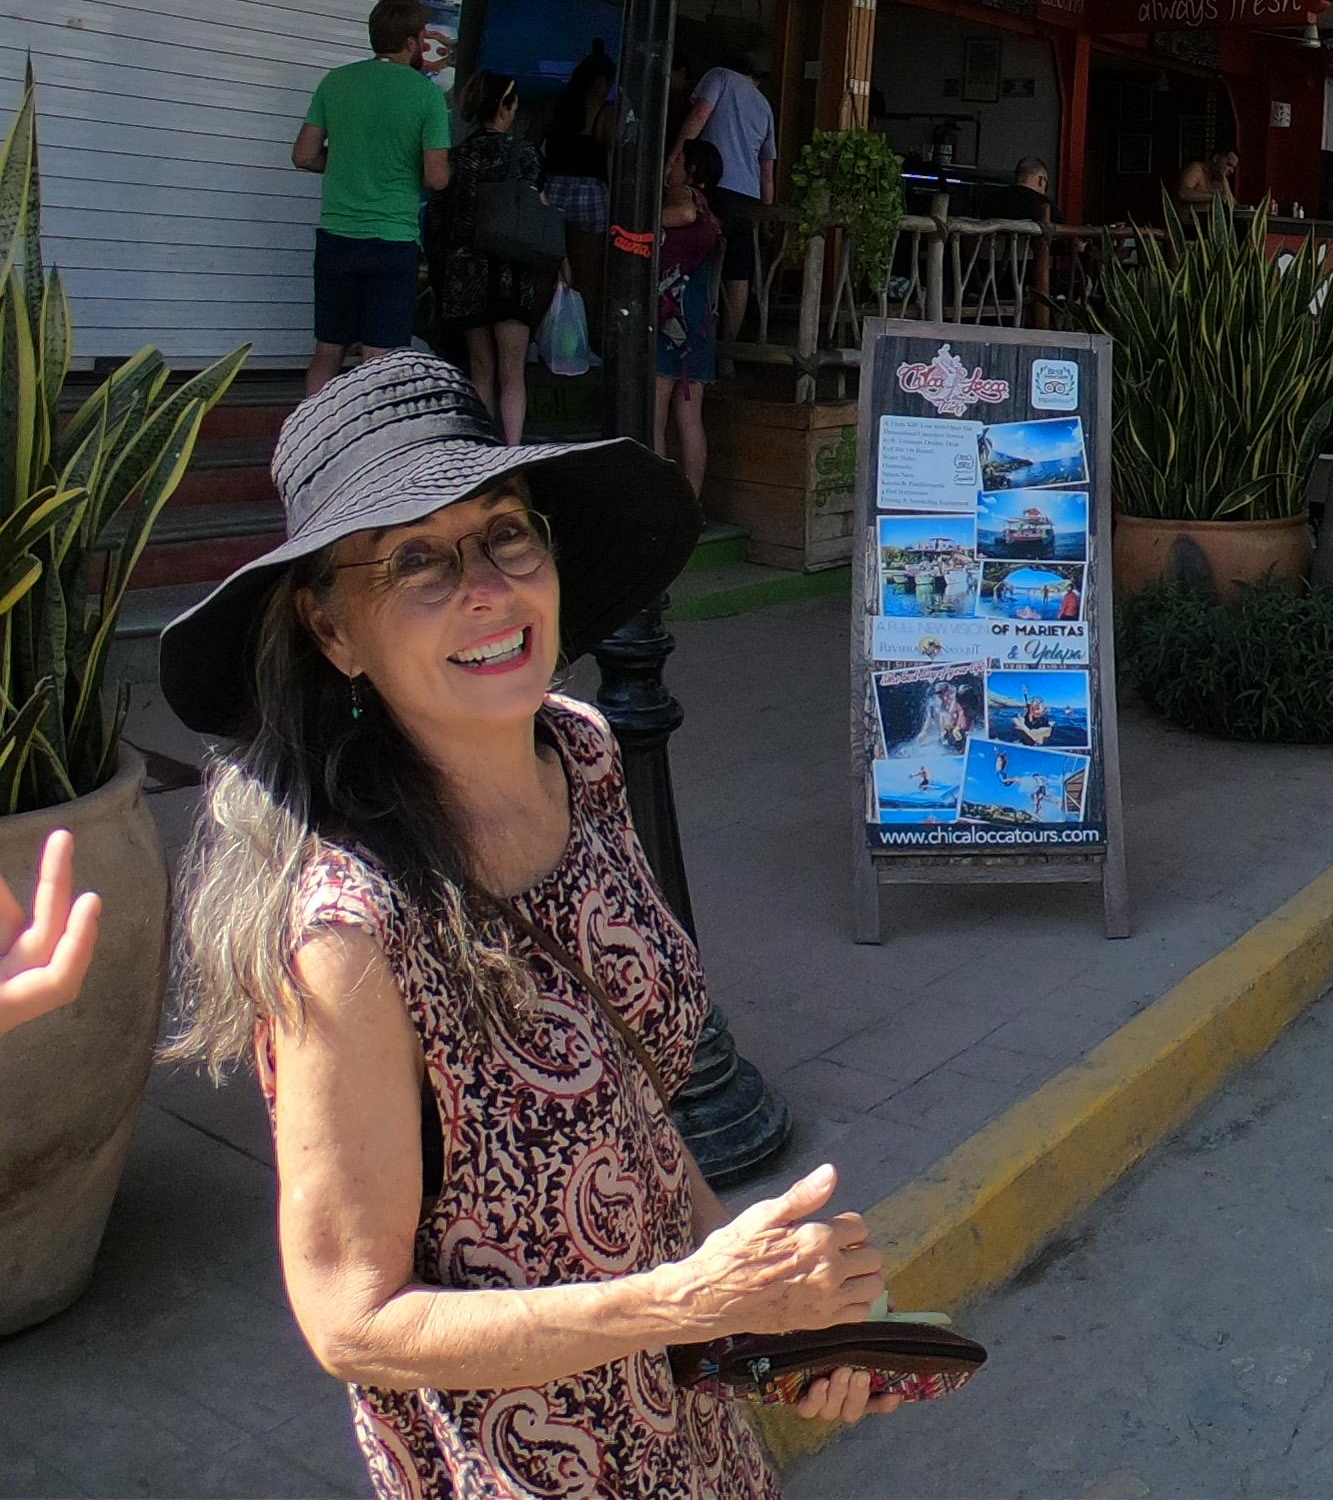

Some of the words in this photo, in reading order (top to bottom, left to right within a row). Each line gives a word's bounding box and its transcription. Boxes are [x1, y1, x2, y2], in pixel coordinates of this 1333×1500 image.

[991, 624, 1009, 636] OF
[1015, 625, 1084, 637] MARIETAS
[1007, 646, 1019, 660] &
[1024, 639, 1084, 668] Yelapa
[879, 826, 1099, 844] www.chicaloccatours.com
